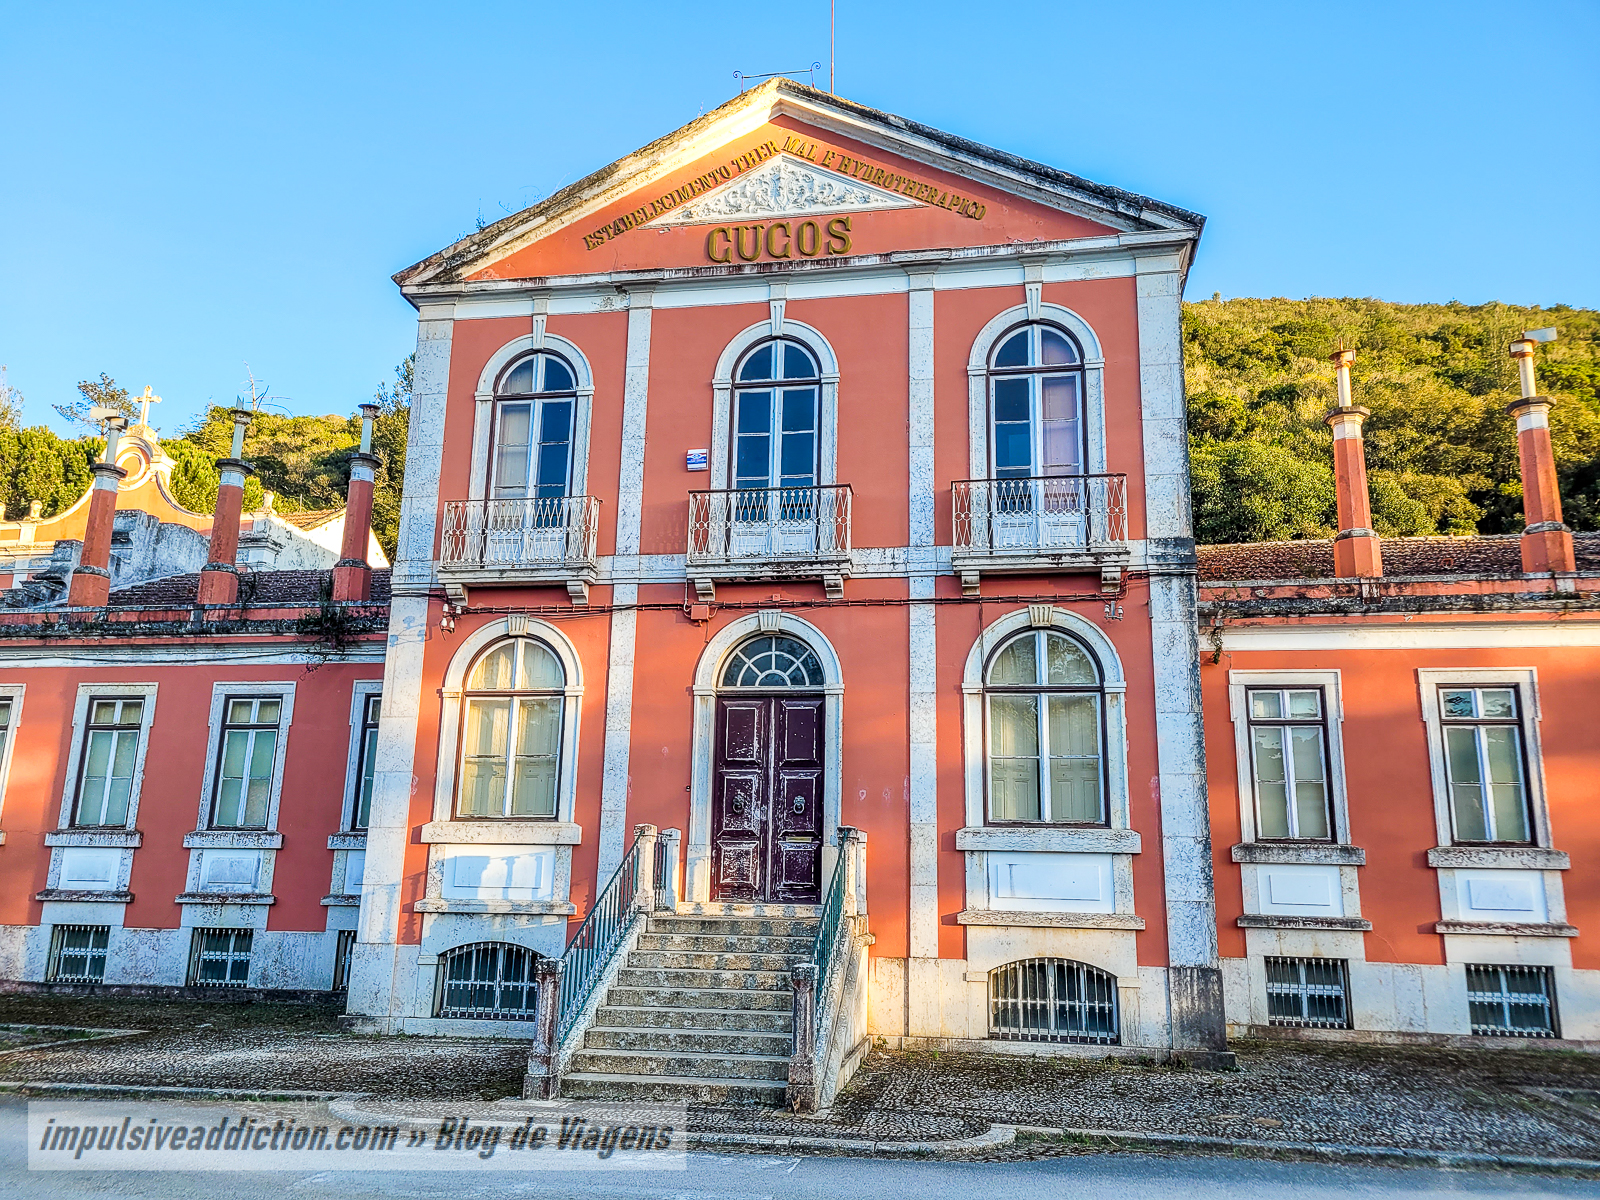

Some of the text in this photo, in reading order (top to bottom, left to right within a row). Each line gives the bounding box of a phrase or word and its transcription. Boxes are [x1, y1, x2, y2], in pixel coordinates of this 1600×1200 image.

[582, 165, 733, 251] ESTABELECIMENTO
[836, 154, 987, 220] HYDROTHERAPICO
[707, 216, 853, 264] CUCOS
